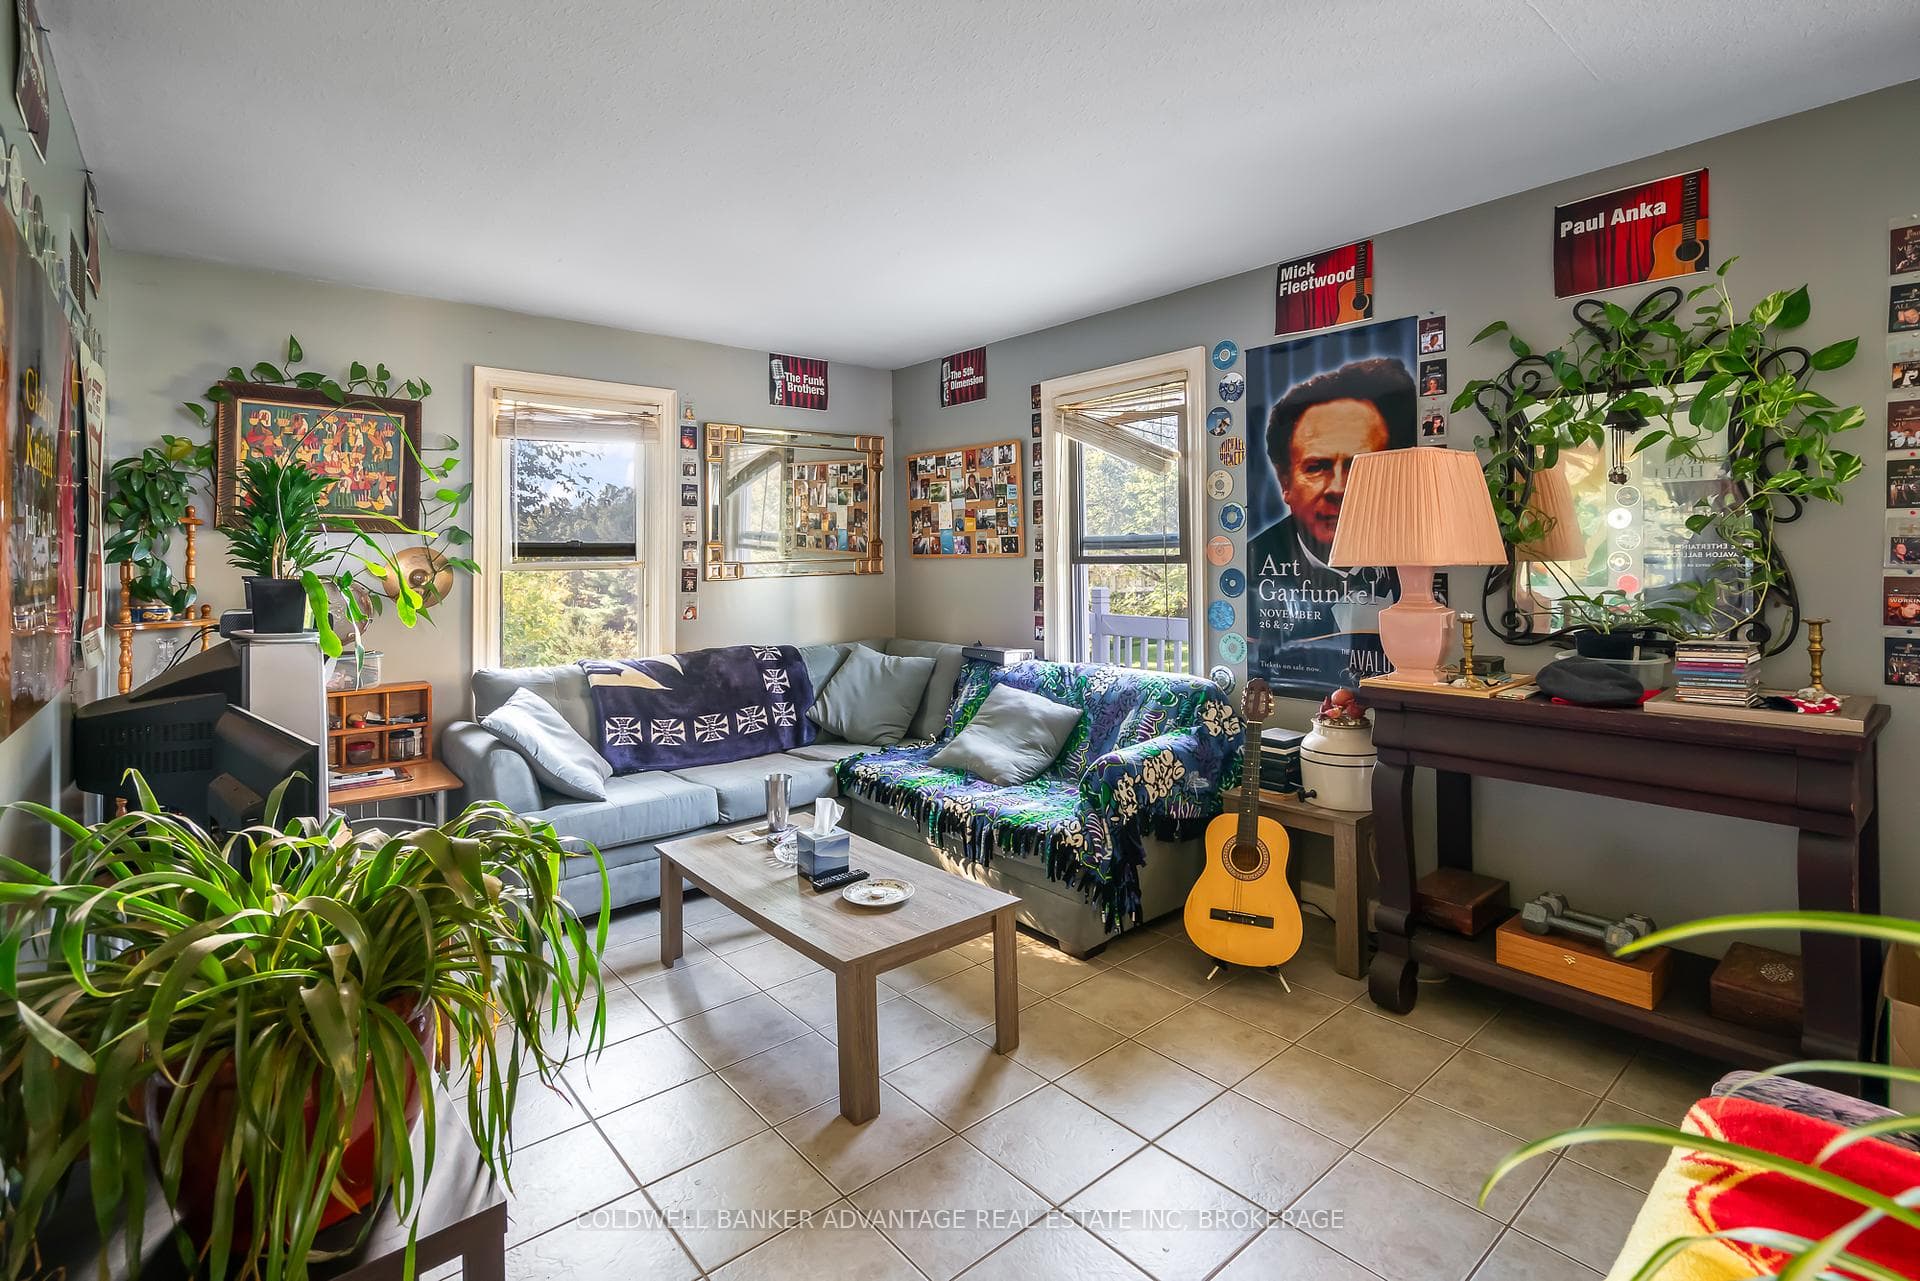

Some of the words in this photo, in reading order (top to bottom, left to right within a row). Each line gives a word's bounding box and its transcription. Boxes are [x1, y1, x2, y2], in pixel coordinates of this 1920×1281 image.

[1560, 212, 1604, 238] Paul
[1610, 201, 1667, 226] Anka
[1281, 261, 1316, 282] Mick
[1280, 265, 1356, 297] Fleetwood
[785, 371, 801, 383] The
[803, 374, 825, 387] Funk
[950, 370, 962, 381] The
[950, 375, 984, 390] Dimension
[787, 381, 825, 396] Brothers
[26, 424, 54, 488] Knight
[1259, 553, 1301, 577] Art
[1259, 578, 1378, 605] Garfunkel
[1259, 608, 1322, 620] NOVEMBER
[1259, 621, 1271, 629] 26
[1273, 621, 1281, 629] &
[1283, 623, 1295, 632] 27
[1261, 661, 1282, 669] Tickets
